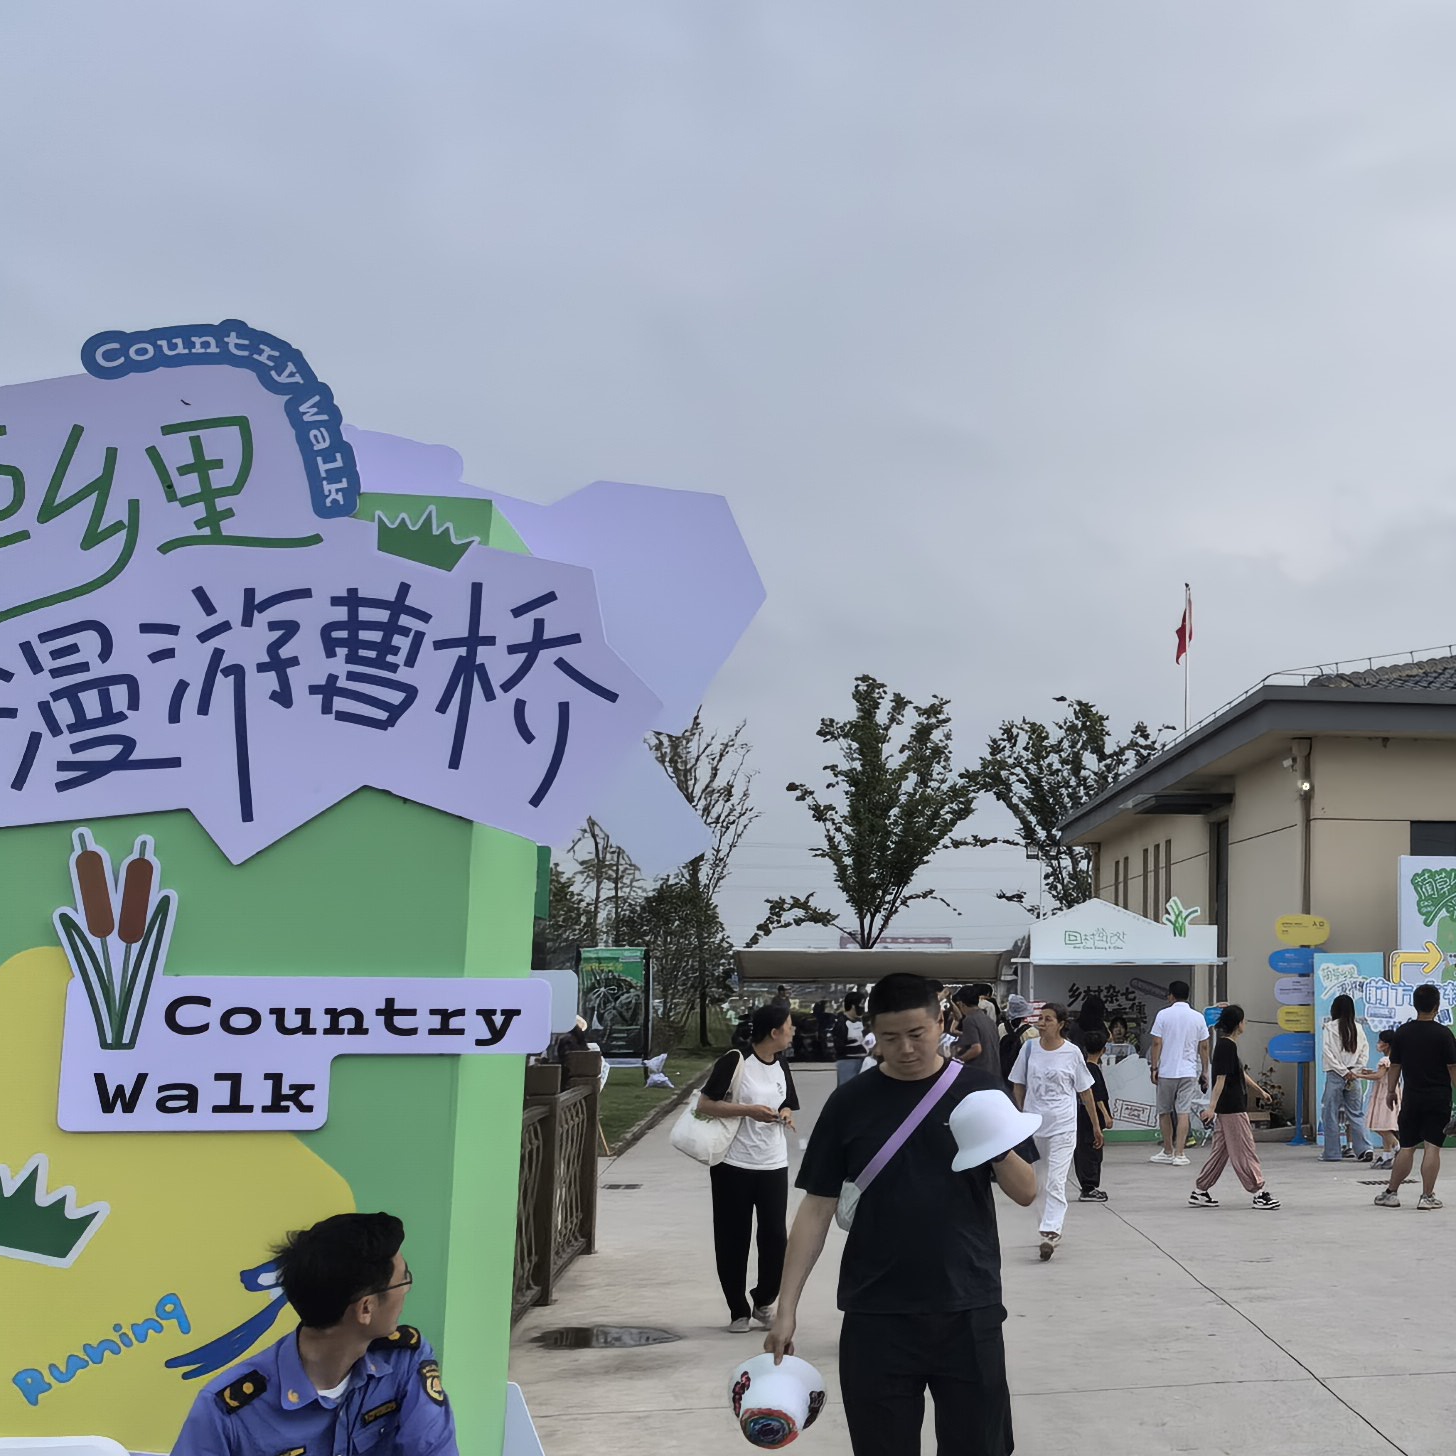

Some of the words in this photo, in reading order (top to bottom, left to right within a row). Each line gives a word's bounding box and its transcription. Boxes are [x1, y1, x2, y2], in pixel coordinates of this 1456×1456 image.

[94, 331, 304, 385] Country
[298, 394, 344, 507] Walk
[162, 993, 522, 1049] Country
[92, 1071, 317, 1118] Walk
[11, 1292, 192, 1407] Runing
